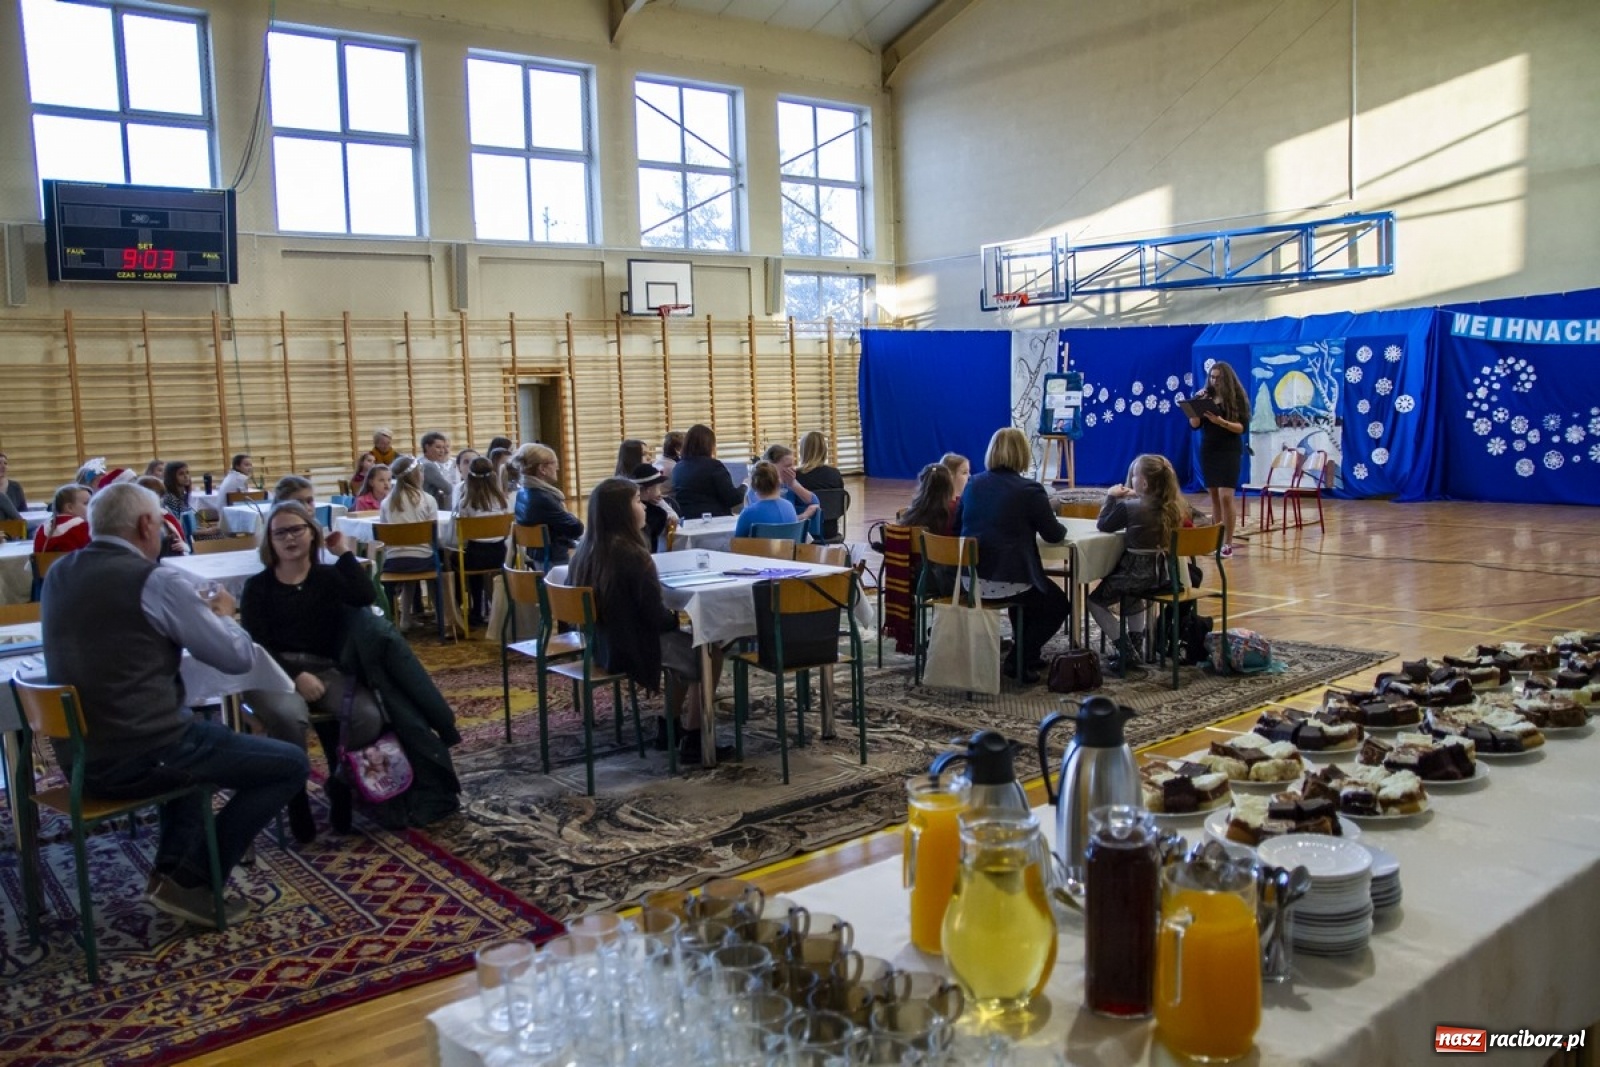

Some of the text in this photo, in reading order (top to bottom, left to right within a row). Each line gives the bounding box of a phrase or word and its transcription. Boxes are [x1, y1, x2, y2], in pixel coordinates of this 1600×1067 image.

[123, 248, 174, 270] 9:03
[116, 271, 136, 279] CZAS
[143, 272, 162, 280] CZAS
[162, 272, 177, 280] GRY
[1453, 312, 1600, 342] WEIHNACH
